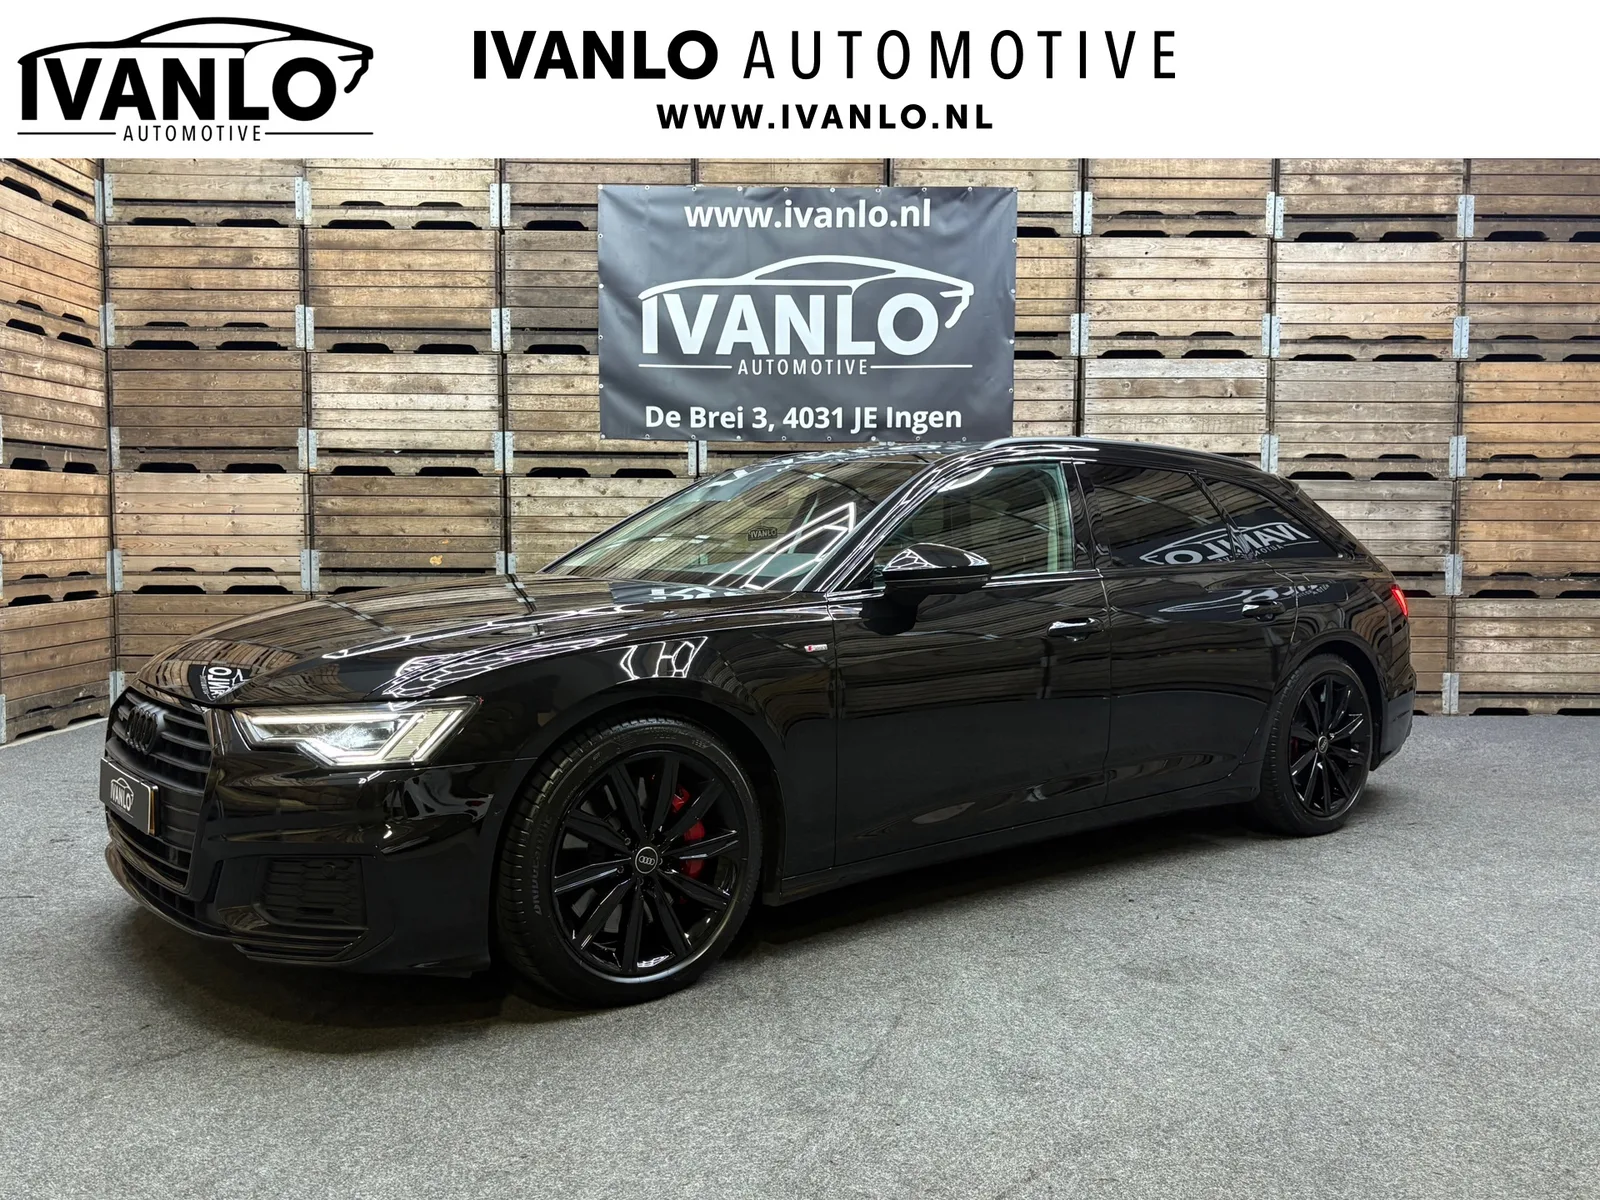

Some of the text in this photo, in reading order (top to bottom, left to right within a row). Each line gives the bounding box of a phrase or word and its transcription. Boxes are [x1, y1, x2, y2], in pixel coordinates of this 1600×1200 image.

[684, 199, 931, 229] www.ivanlo.nl
[641, 292, 939, 356] IVANLO
[737, 358, 868, 376] AUTOMOTIVE
[645, 405, 963, 435] De Brei 3, 4031 JE Ingen
[110, 783, 132, 812] IVANLO
